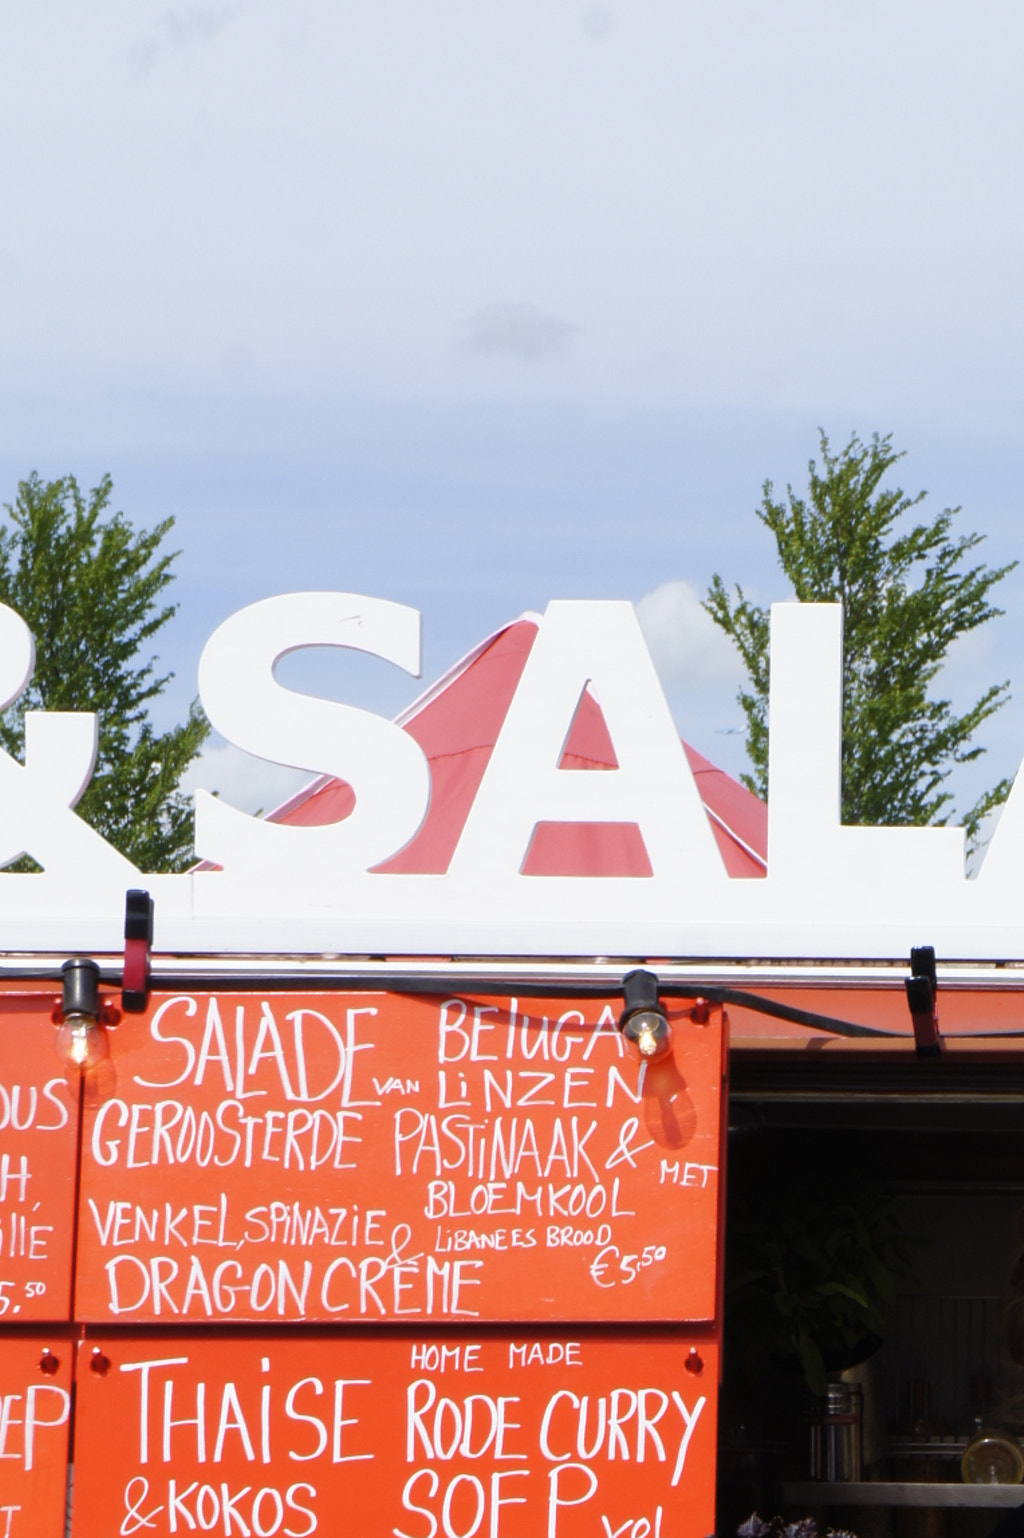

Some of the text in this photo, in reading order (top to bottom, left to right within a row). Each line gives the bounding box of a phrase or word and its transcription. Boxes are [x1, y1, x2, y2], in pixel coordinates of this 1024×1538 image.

[133, 996, 420, 1108] SALADE VAN
[92, 1099, 362, 1171] GEROOSTERDE
[605, 1117, 655, 1169] &
[424, 1178, 636, 1219] BLOEMKOOL
[659, 1159, 718, 1188] MET
[385, 1223, 424, 1271] &
[547, 1223, 612, 1247] BROOD
[410, 1342, 583, 1373] HOME MADE
[0, 1385, 71, 1471] EP
[406, 1379, 528, 1462] RODE
[539, 1388, 706, 1486] CURRY
[169, 1479, 318, 1538] KOKOS
